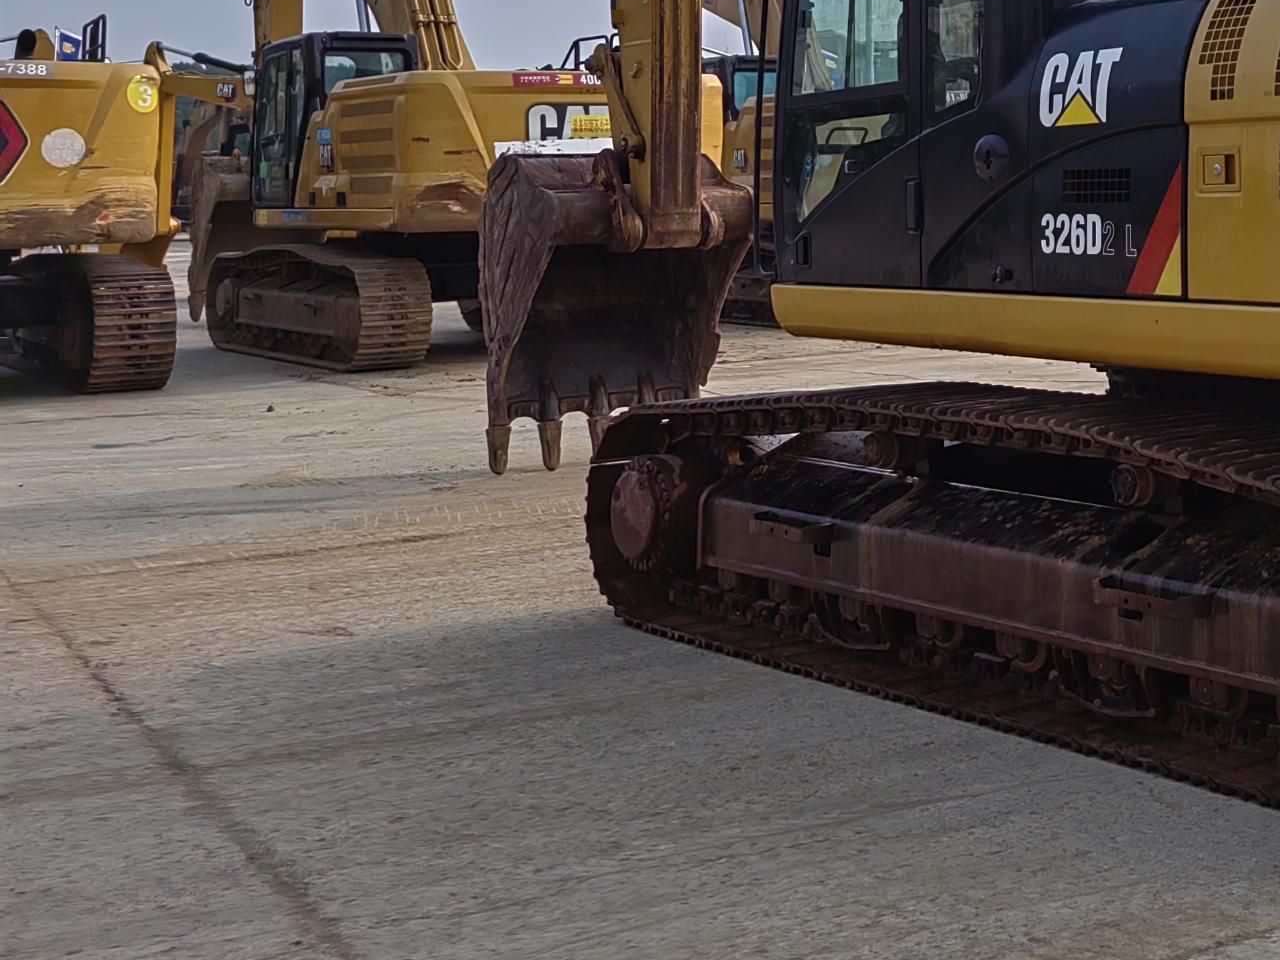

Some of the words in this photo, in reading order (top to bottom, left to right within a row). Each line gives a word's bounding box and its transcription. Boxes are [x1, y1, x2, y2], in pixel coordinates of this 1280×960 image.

[138, 85, 152, 107] 3
[217, 83, 234, 98] CAT
[1039, 47, 1123, 128] CAT
[319, 144, 332, 167] CAT
[1125, 224, 1137, 257] L
